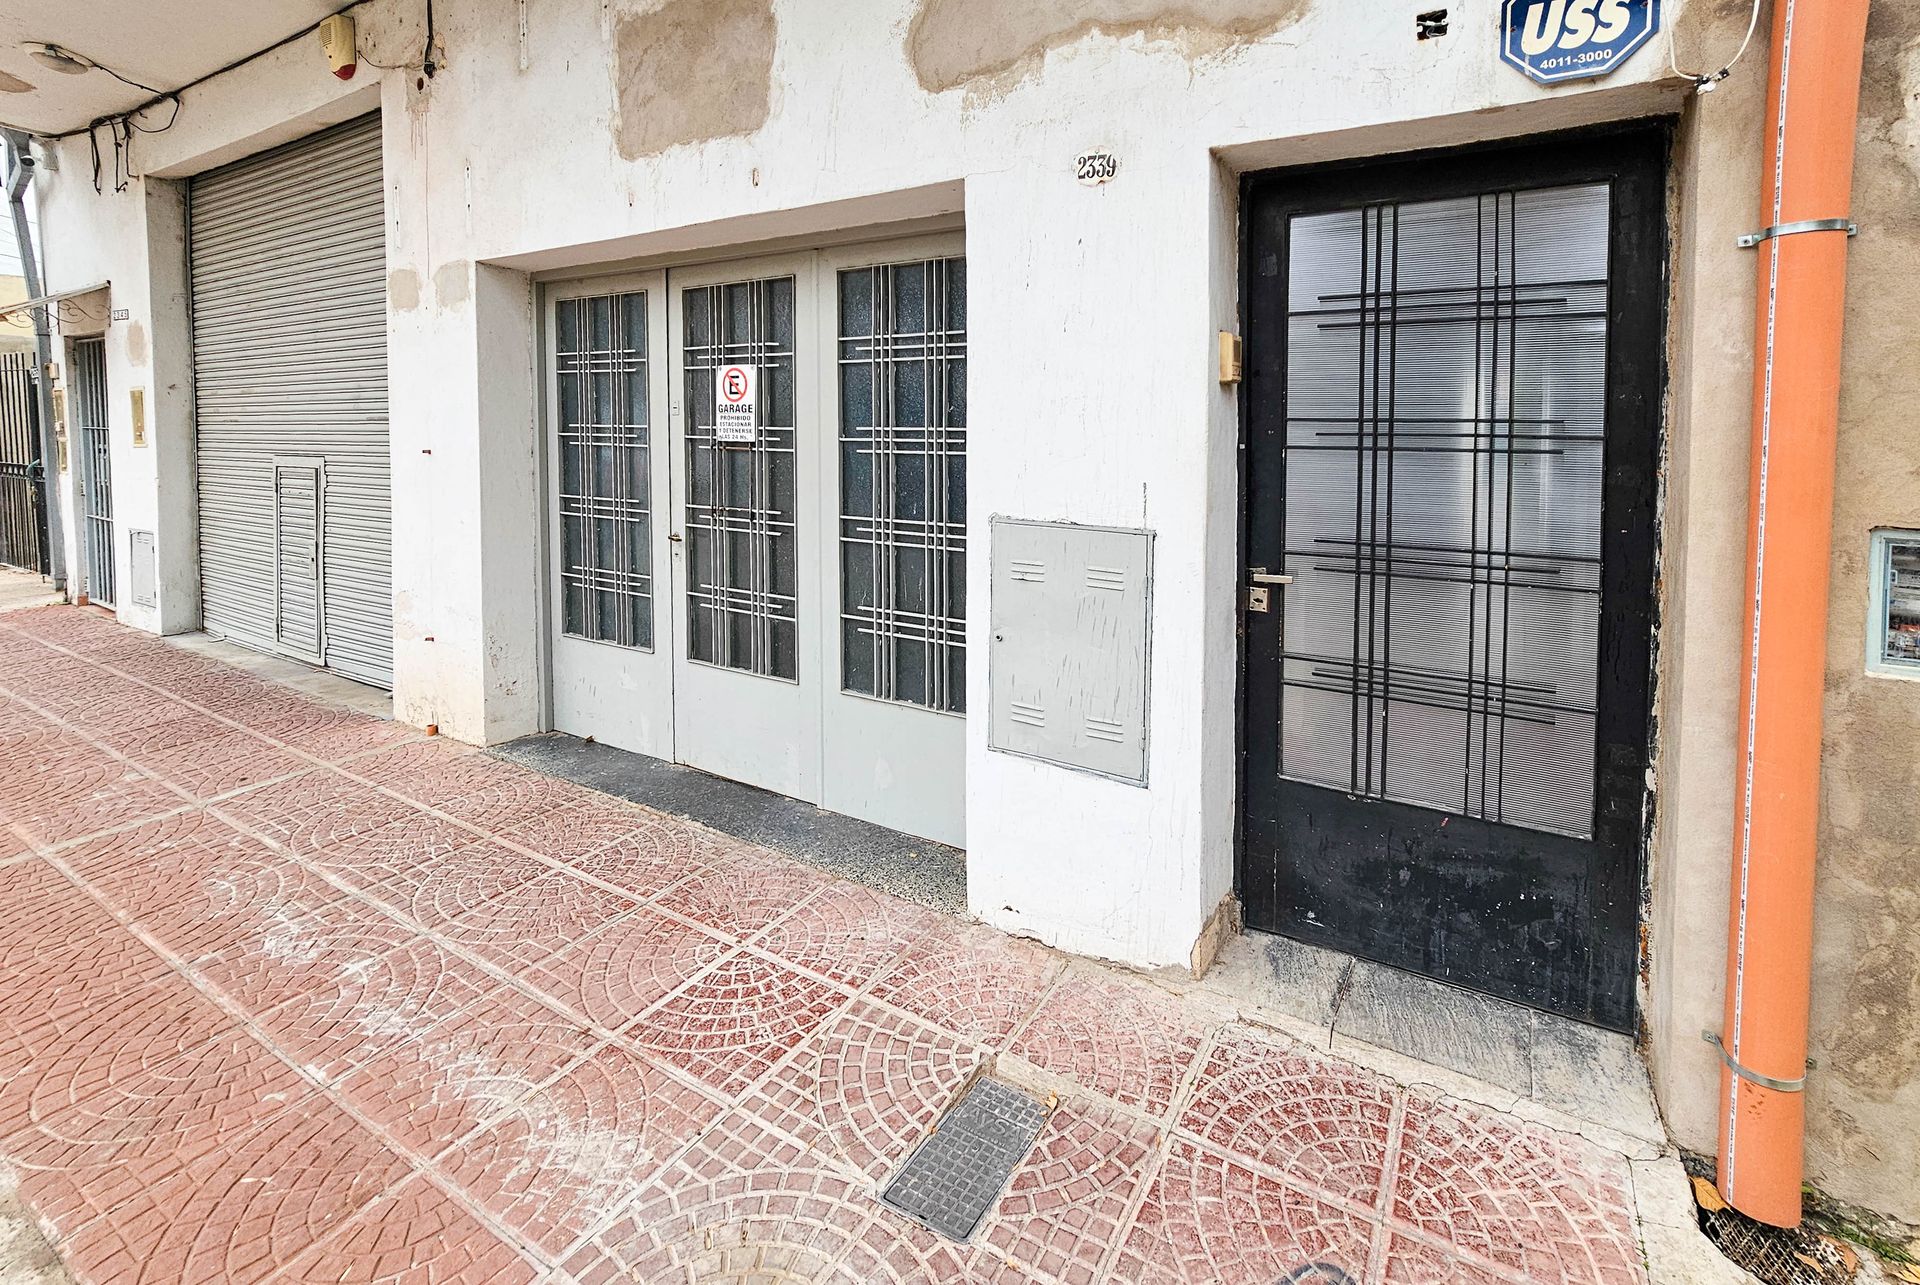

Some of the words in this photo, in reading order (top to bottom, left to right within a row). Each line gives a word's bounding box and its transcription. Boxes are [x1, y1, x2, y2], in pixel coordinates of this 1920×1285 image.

[1521, 0, 1630, 55] USS
[1540, 49, 1612, 69] 4011-3000
[1077, 154, 1117, 179] 2339
[718, 404, 753, 413] GARAGE
